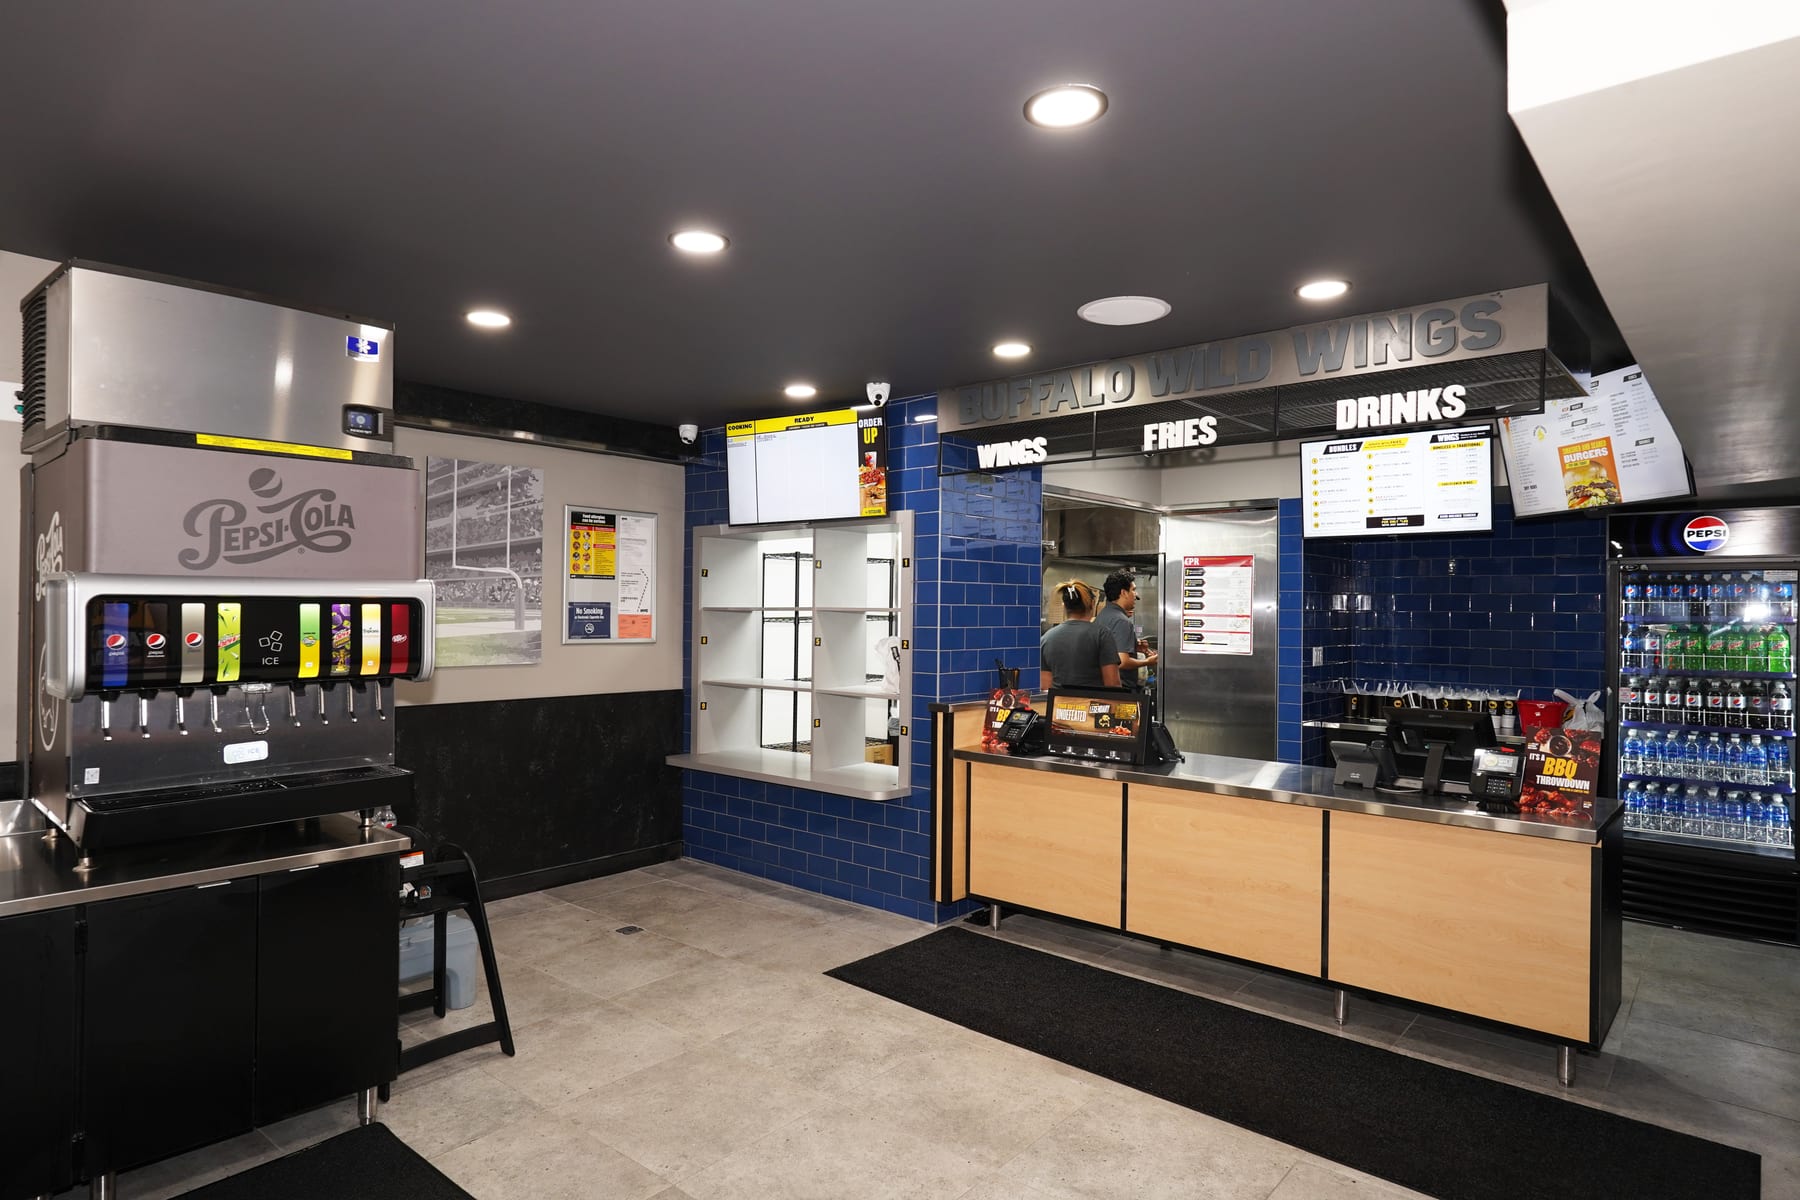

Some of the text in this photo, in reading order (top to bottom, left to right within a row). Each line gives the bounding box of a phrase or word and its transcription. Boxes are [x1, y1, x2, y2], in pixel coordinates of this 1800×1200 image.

[958, 299, 1503, 425] BUFFALO WILD WINGS
[1336, 384, 1466, 431] DRINKS
[859, 417, 883, 428] ORDER
[863, 427, 878, 444] UP
[1143, 416, 1218, 452] FRIES
[1437, 433, 1459, 442] WINGS
[976, 436, 1047, 469] WINGS
[1328, 444, 1358, 453] BUNDLES
[1563, 447, 1608, 463] BURGERS
[1687, 529, 1727, 538] PEPSI
[583, 608, 604, 616] Smoking
[903, 640, 908, 648] 2
[262, 657, 280, 665] ICE
[1056, 709, 1087, 722] UNDEFEATED
[1542, 757, 1578, 781] BBQ
[1536, 775, 1591, 790] THROWDOWN
